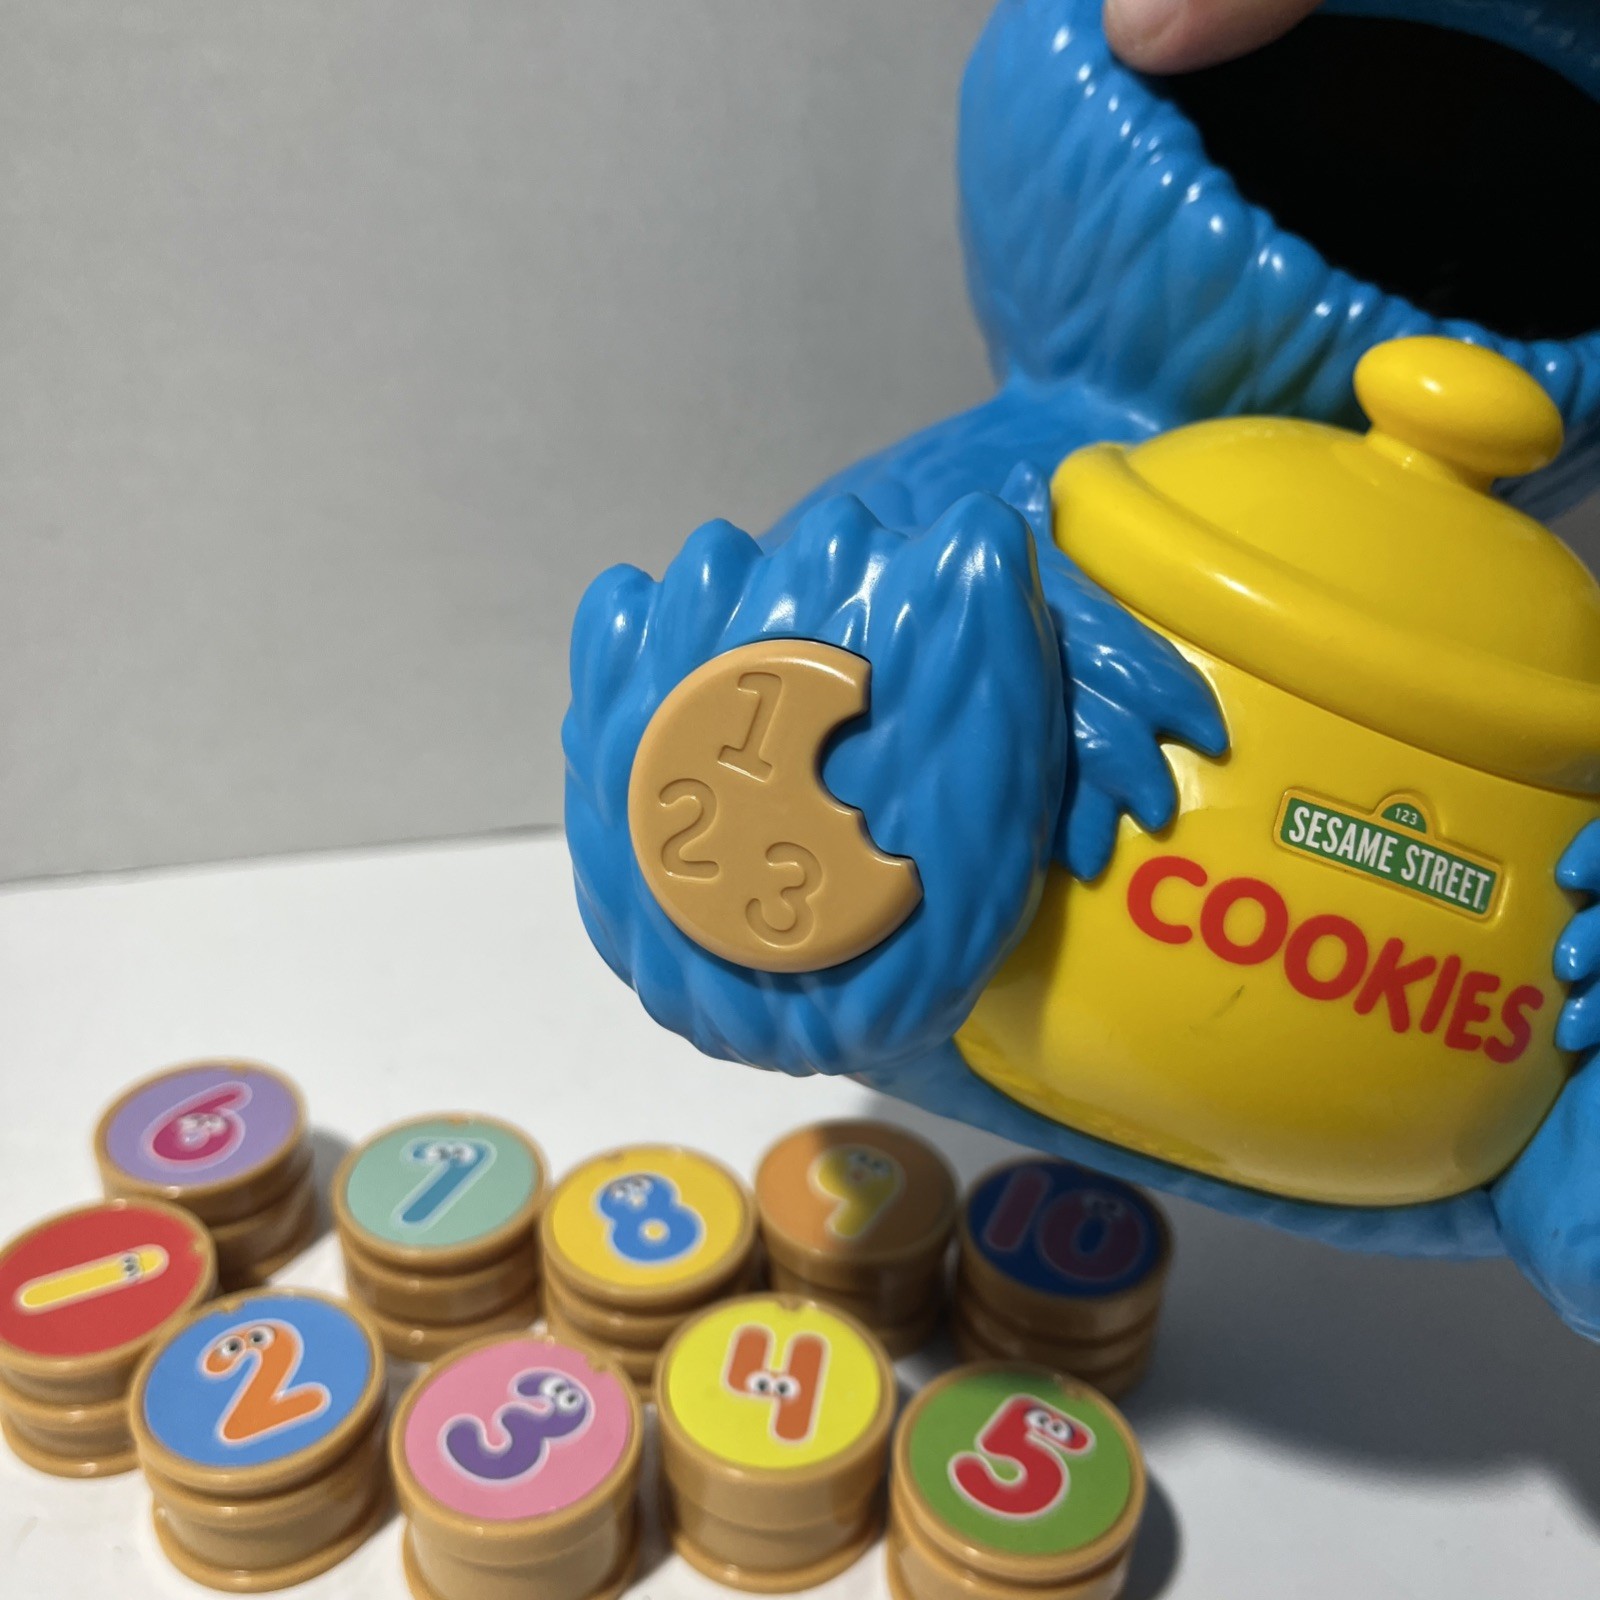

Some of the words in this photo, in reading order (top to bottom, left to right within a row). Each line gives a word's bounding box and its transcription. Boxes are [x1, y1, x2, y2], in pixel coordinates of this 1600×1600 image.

[717, 671, 783, 783] 1
[659, 778, 721, 881] 2
[1288, 806, 1398, 874] SESAME
[1401, 844, 1490, 909] STREET
[1395, 807, 1418, 826] 123
[745, 841, 824, 949] 3
[1127, 855, 1544, 1064] COOKIES
[146, 1083, 250, 1165] 6
[400, 1138, 495, 1226] 7
[598, 1172, 704, 1264] 8
[811, 1145, 902, 1239] 9
[983, 1165, 1144, 1282] 10
[201, 1319, 330, 1443] 2
[441, 1367, 594, 1483] 3
[722, 1324, 829, 1444] 4
[949, 1393, 1096, 1518] 5
